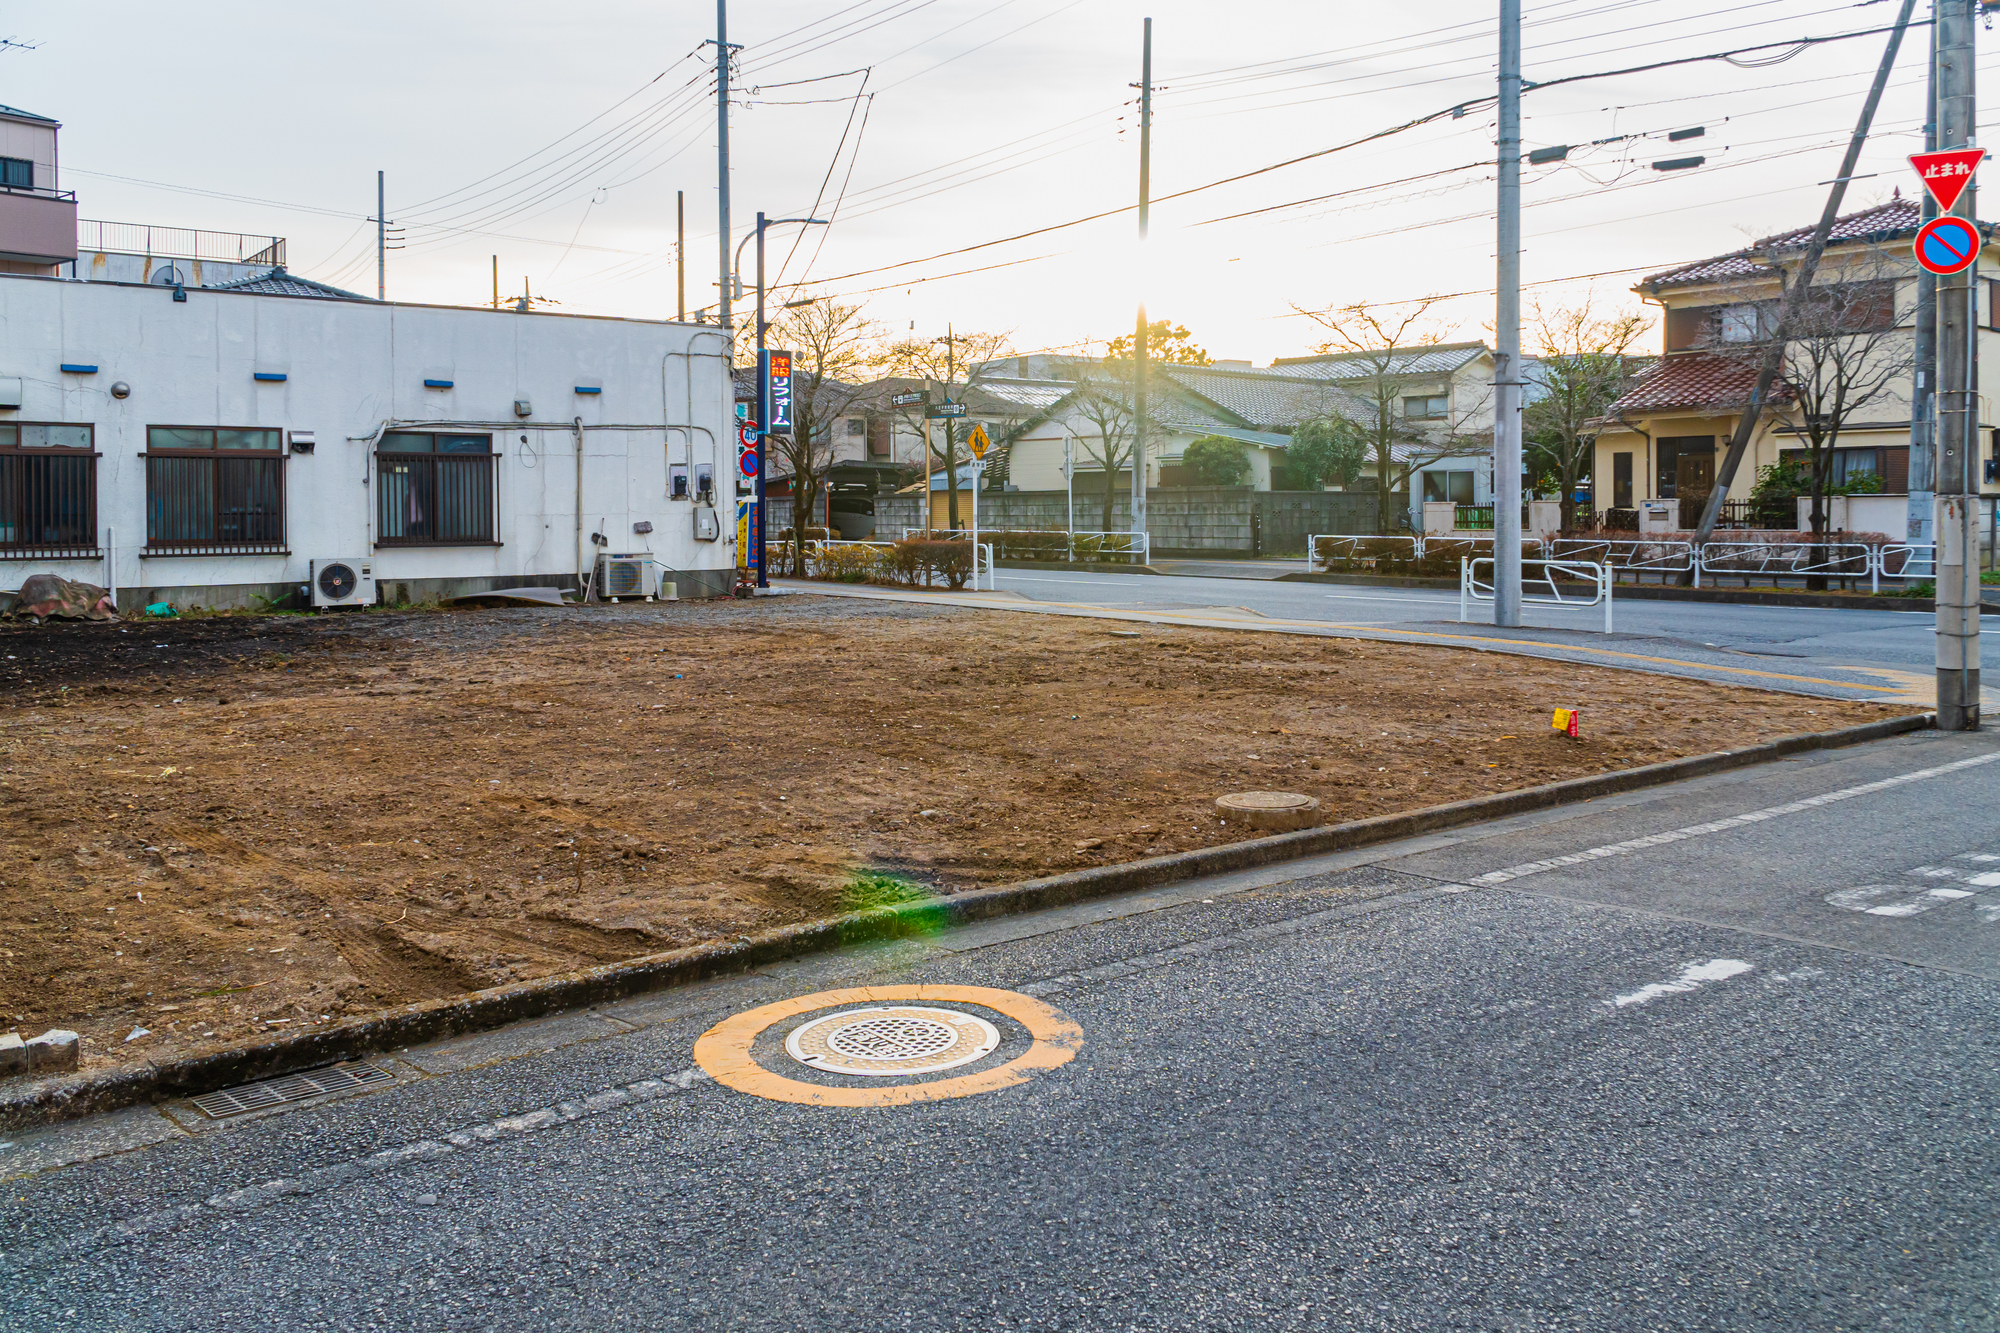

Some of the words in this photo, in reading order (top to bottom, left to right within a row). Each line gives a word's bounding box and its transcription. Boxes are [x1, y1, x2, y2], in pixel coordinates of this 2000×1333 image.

[1925, 161, 1971, 178] 止まれ
[744, 428, 757, 441] 40
